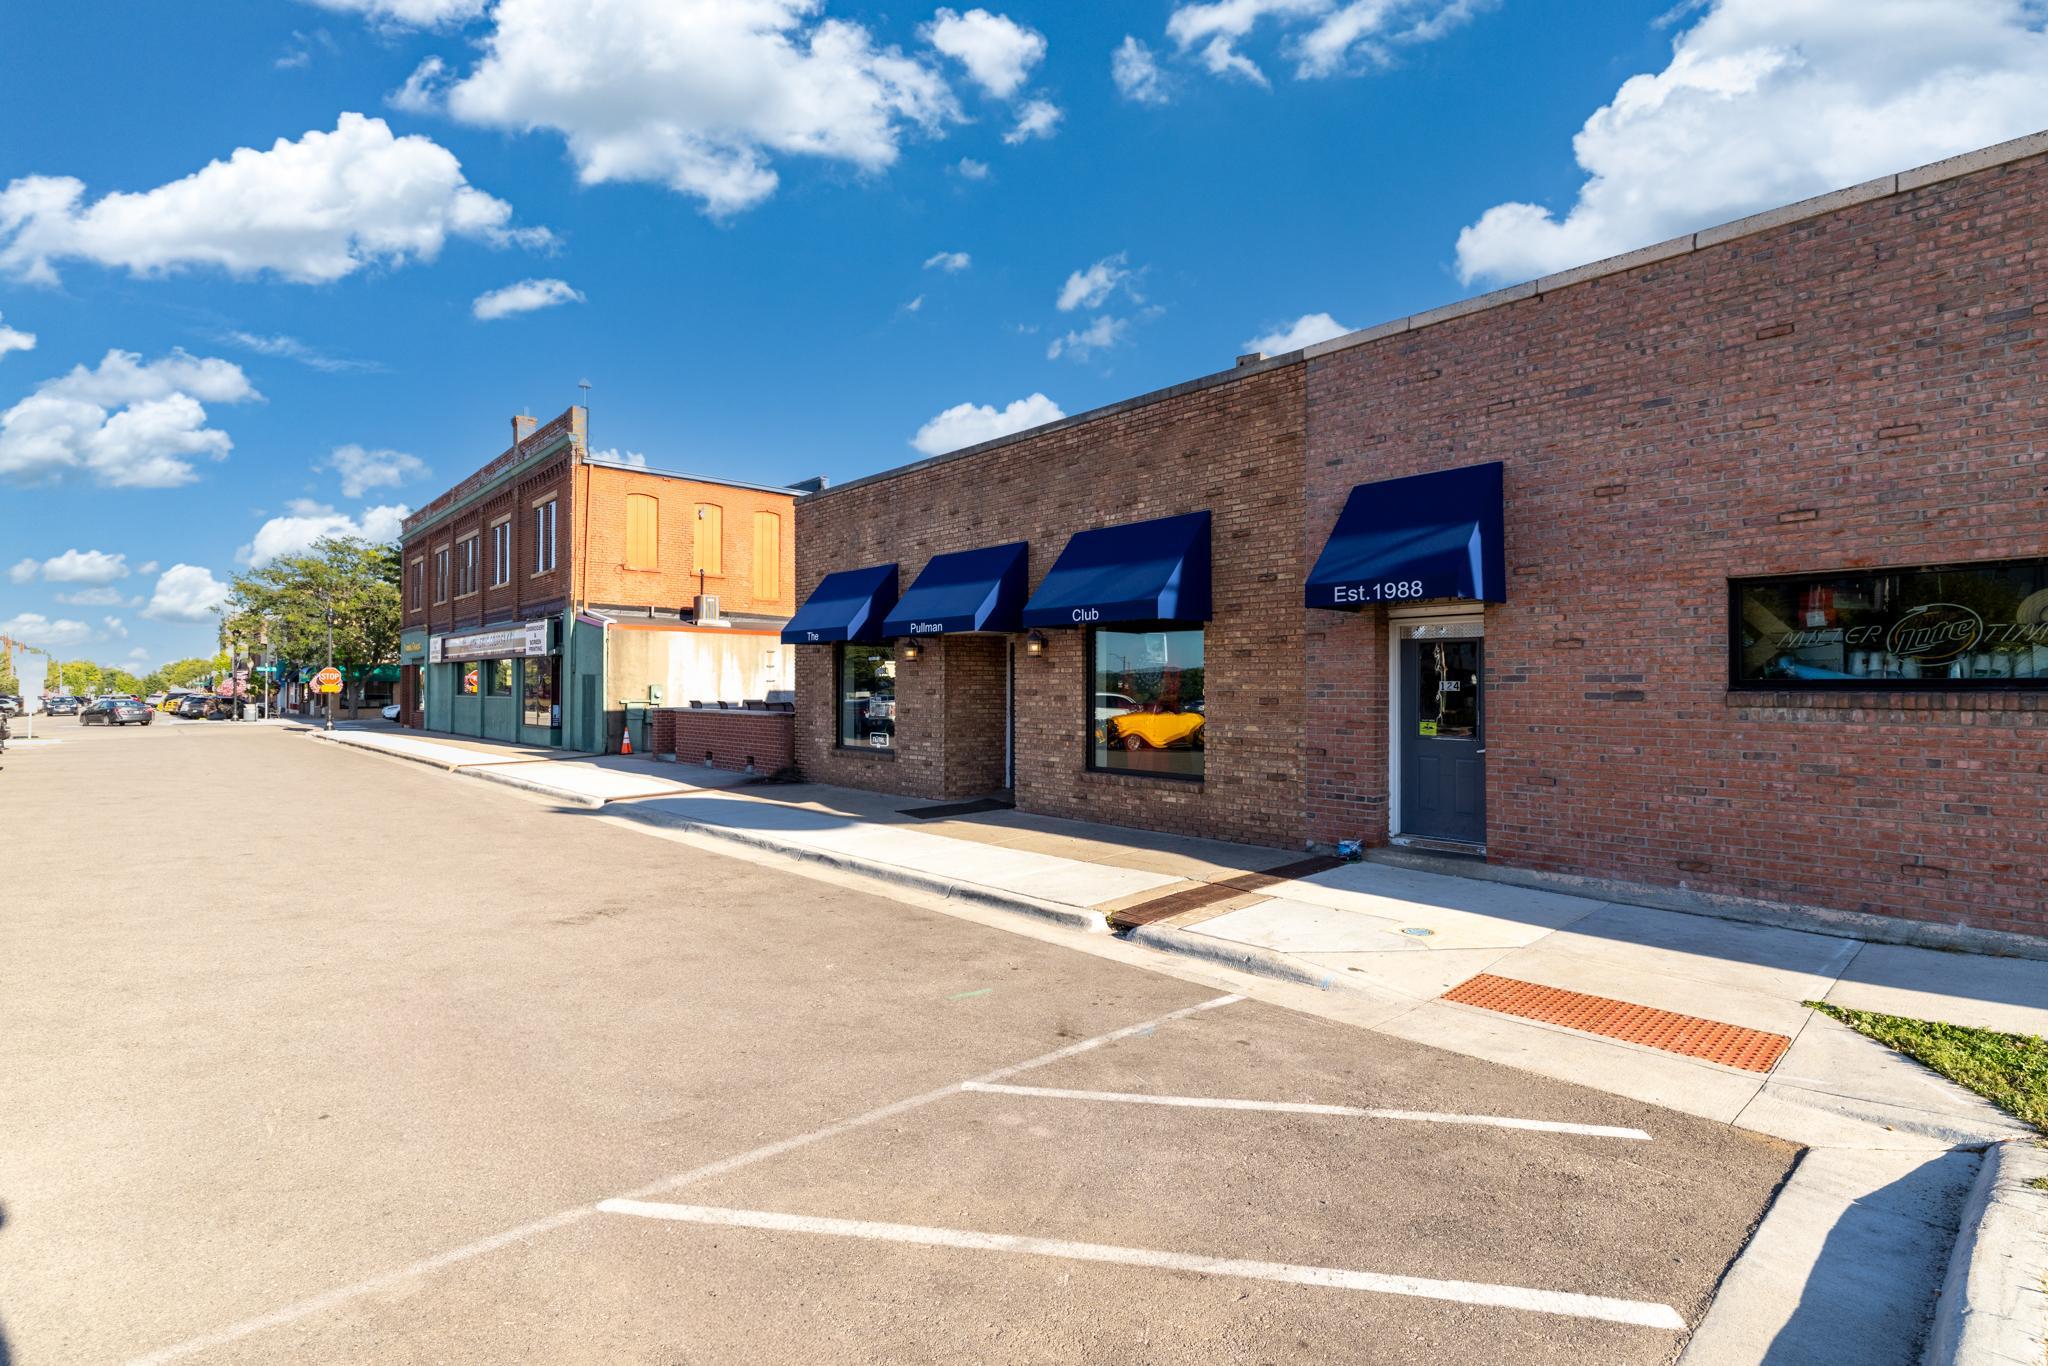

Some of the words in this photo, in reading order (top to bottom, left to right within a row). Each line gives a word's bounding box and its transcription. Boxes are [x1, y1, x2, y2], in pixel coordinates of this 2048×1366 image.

[1072, 608, 1099, 621] Club
[910, 623, 943, 634] Pullman
[807, 632, 819, 641] The
[1440, 682, 1459, 691] 124
